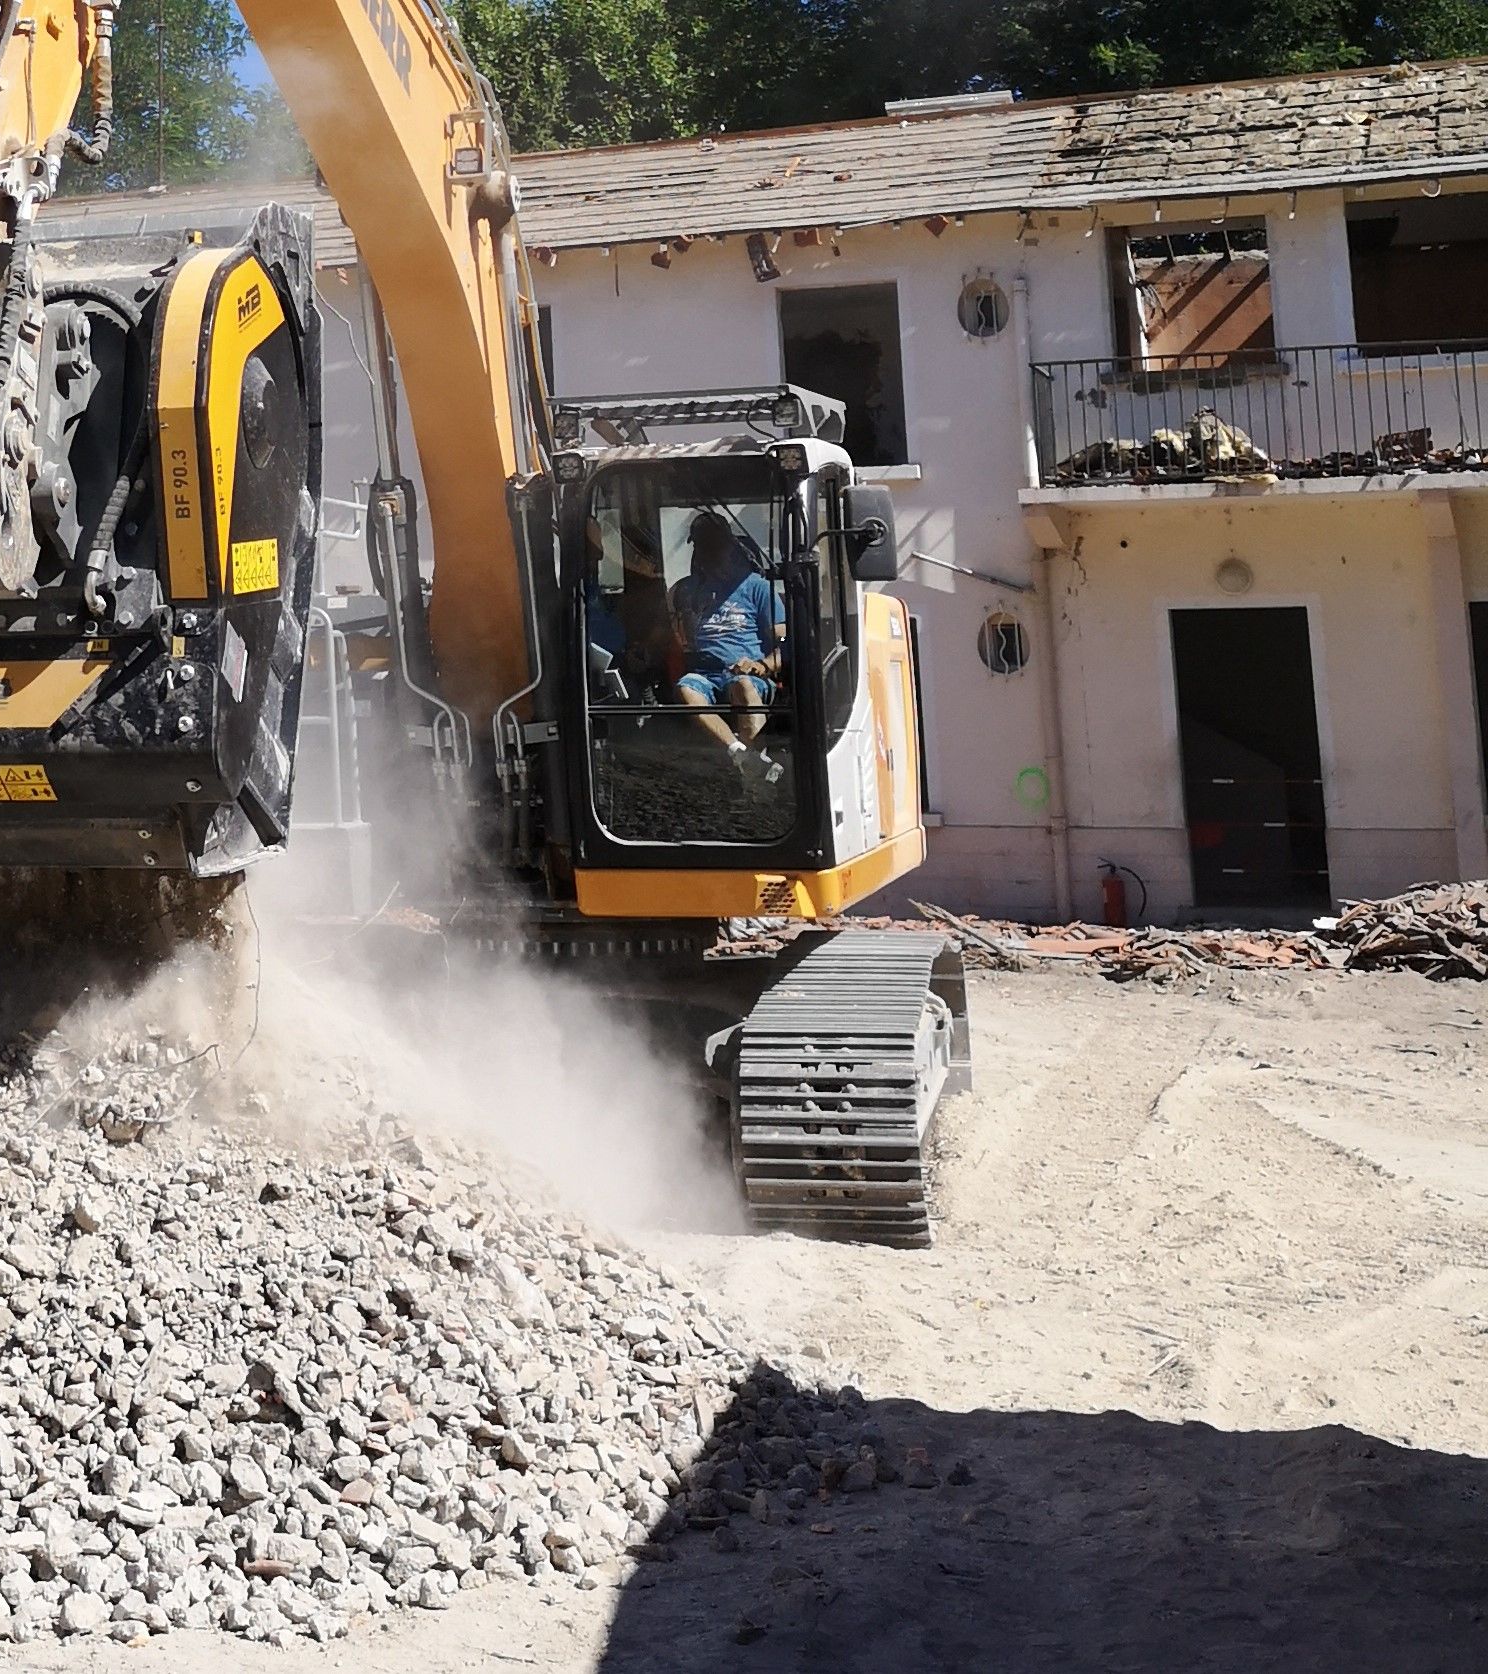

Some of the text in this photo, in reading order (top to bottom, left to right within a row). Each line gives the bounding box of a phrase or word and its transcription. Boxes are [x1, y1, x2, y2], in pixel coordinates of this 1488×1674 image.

[237, 283, 261, 323] MB
[172, 449, 191, 519] BF 90.3
